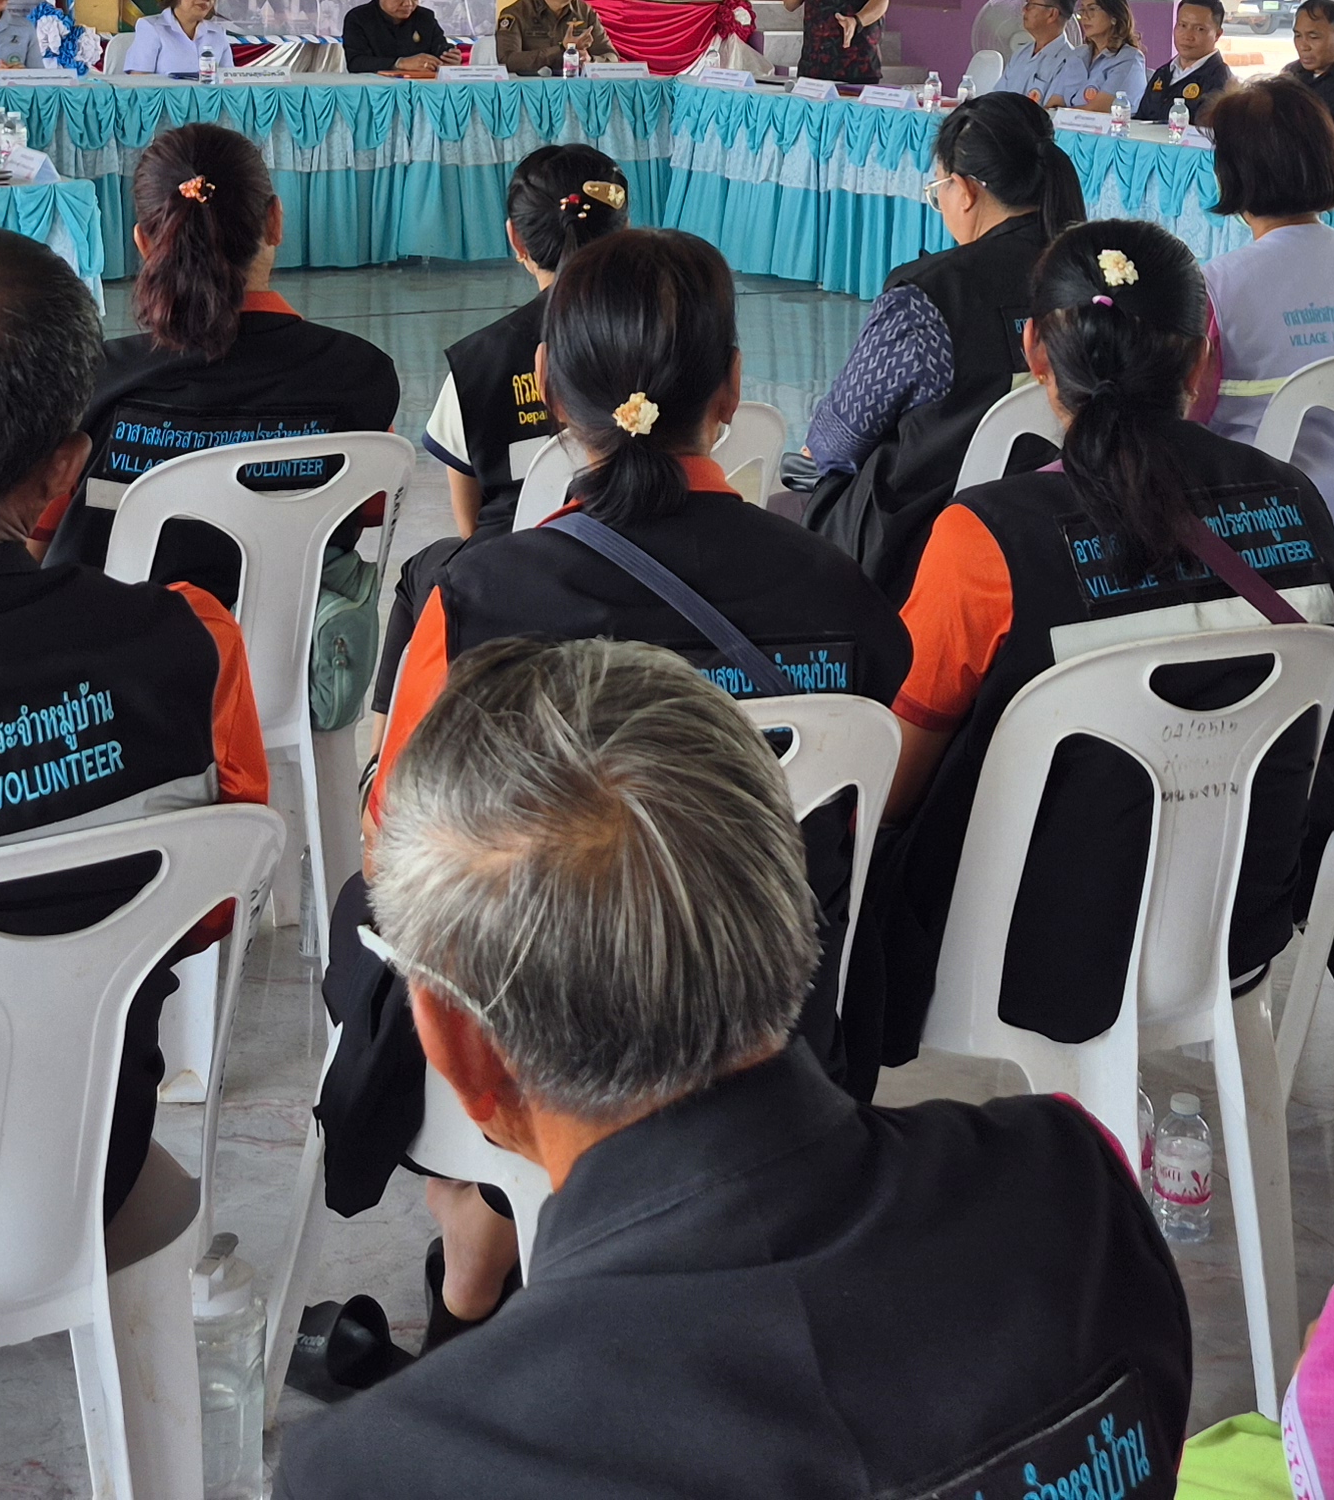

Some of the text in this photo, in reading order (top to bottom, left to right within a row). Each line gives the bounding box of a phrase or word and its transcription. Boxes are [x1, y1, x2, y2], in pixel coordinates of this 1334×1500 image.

[1289, 330, 1329, 346] VILLAGE
[512, 371, 542, 407] กรม
[110, 451, 324, 479] VILLA VOLUNTEER
[1237, 539, 1315, 570] OLUNTEER
